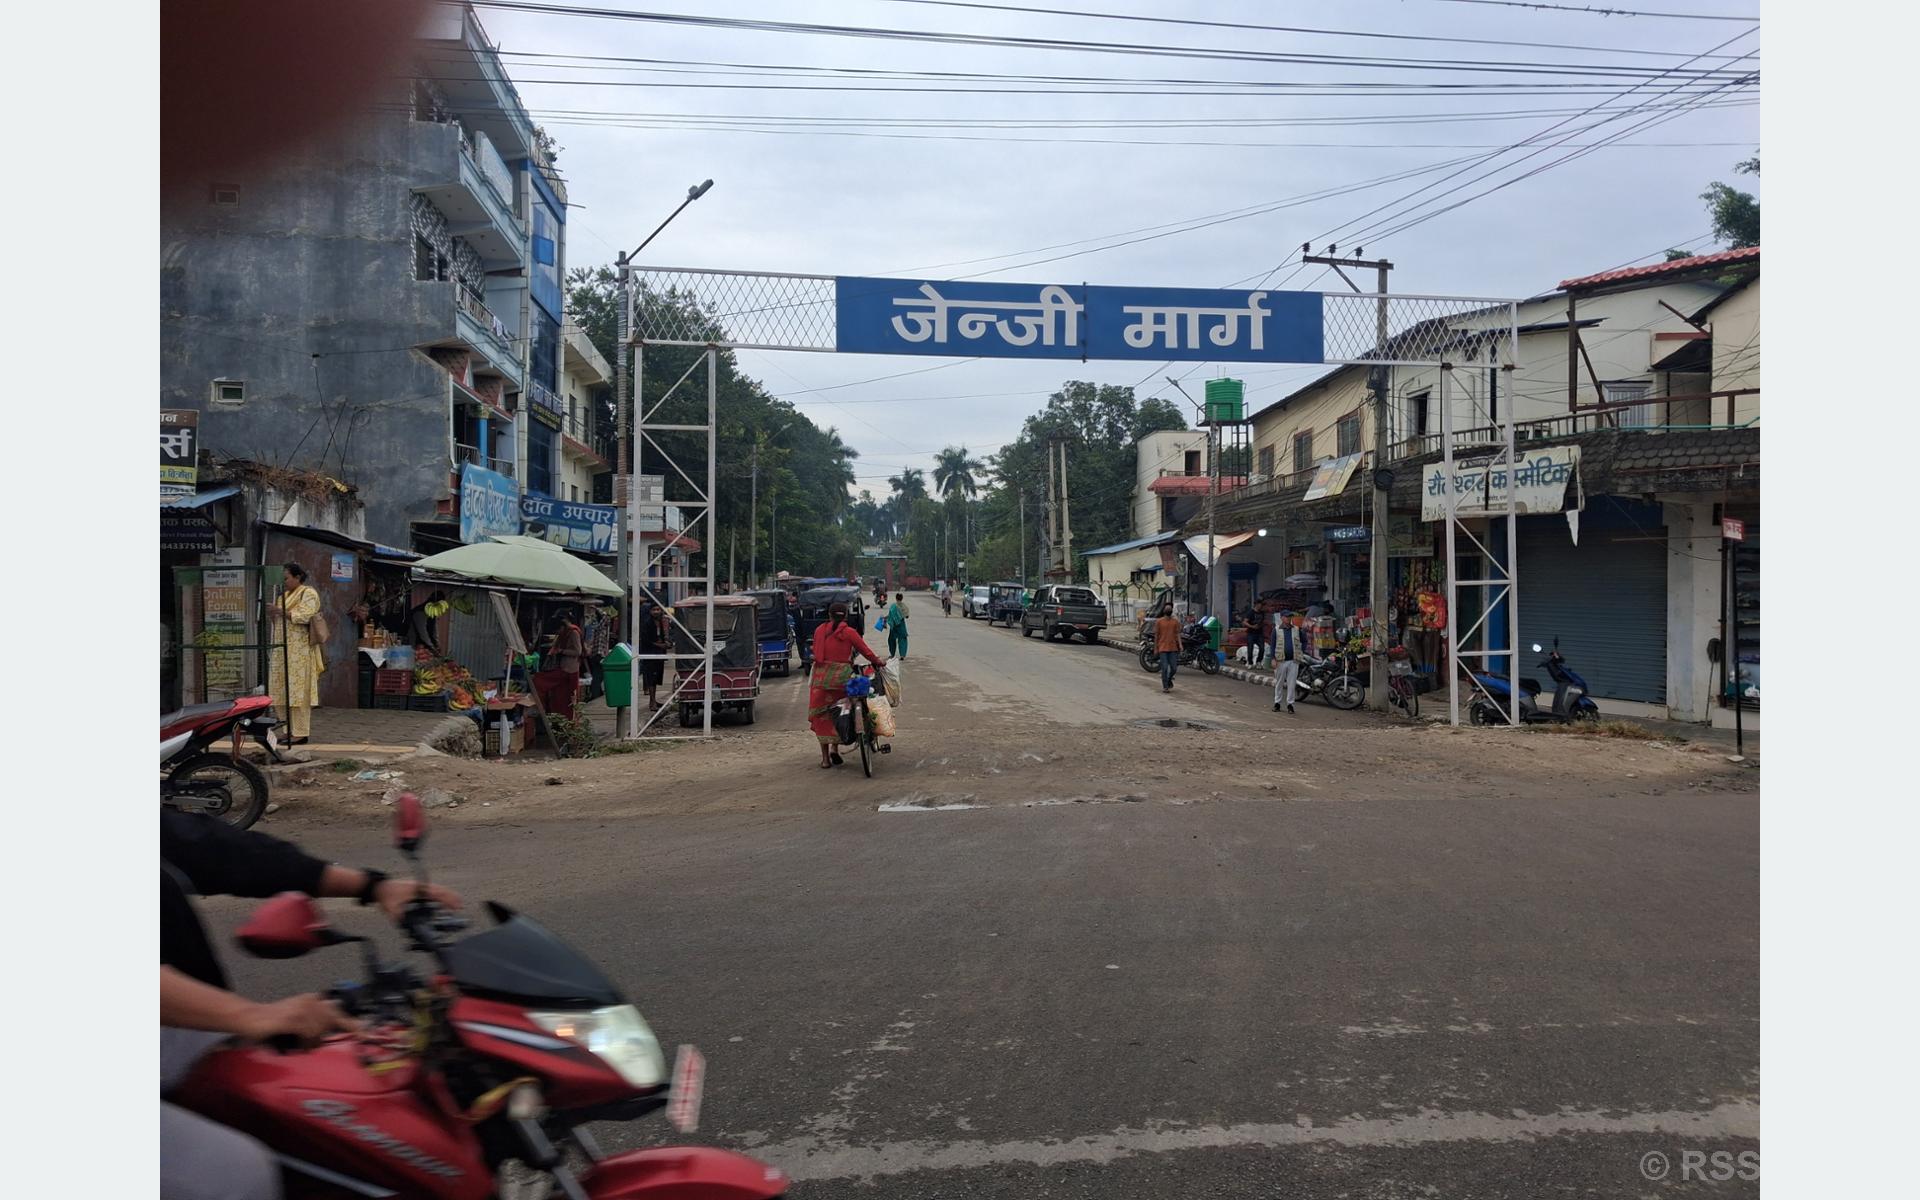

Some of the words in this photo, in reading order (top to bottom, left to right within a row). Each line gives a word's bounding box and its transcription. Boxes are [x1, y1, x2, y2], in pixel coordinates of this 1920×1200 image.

[892, 283, 1084, 346] जेन्जी
[1123, 292, 1272, 350] मार्ग
[562, 505, 614, 524] उपचार
[208, 600, 238, 610] Form
